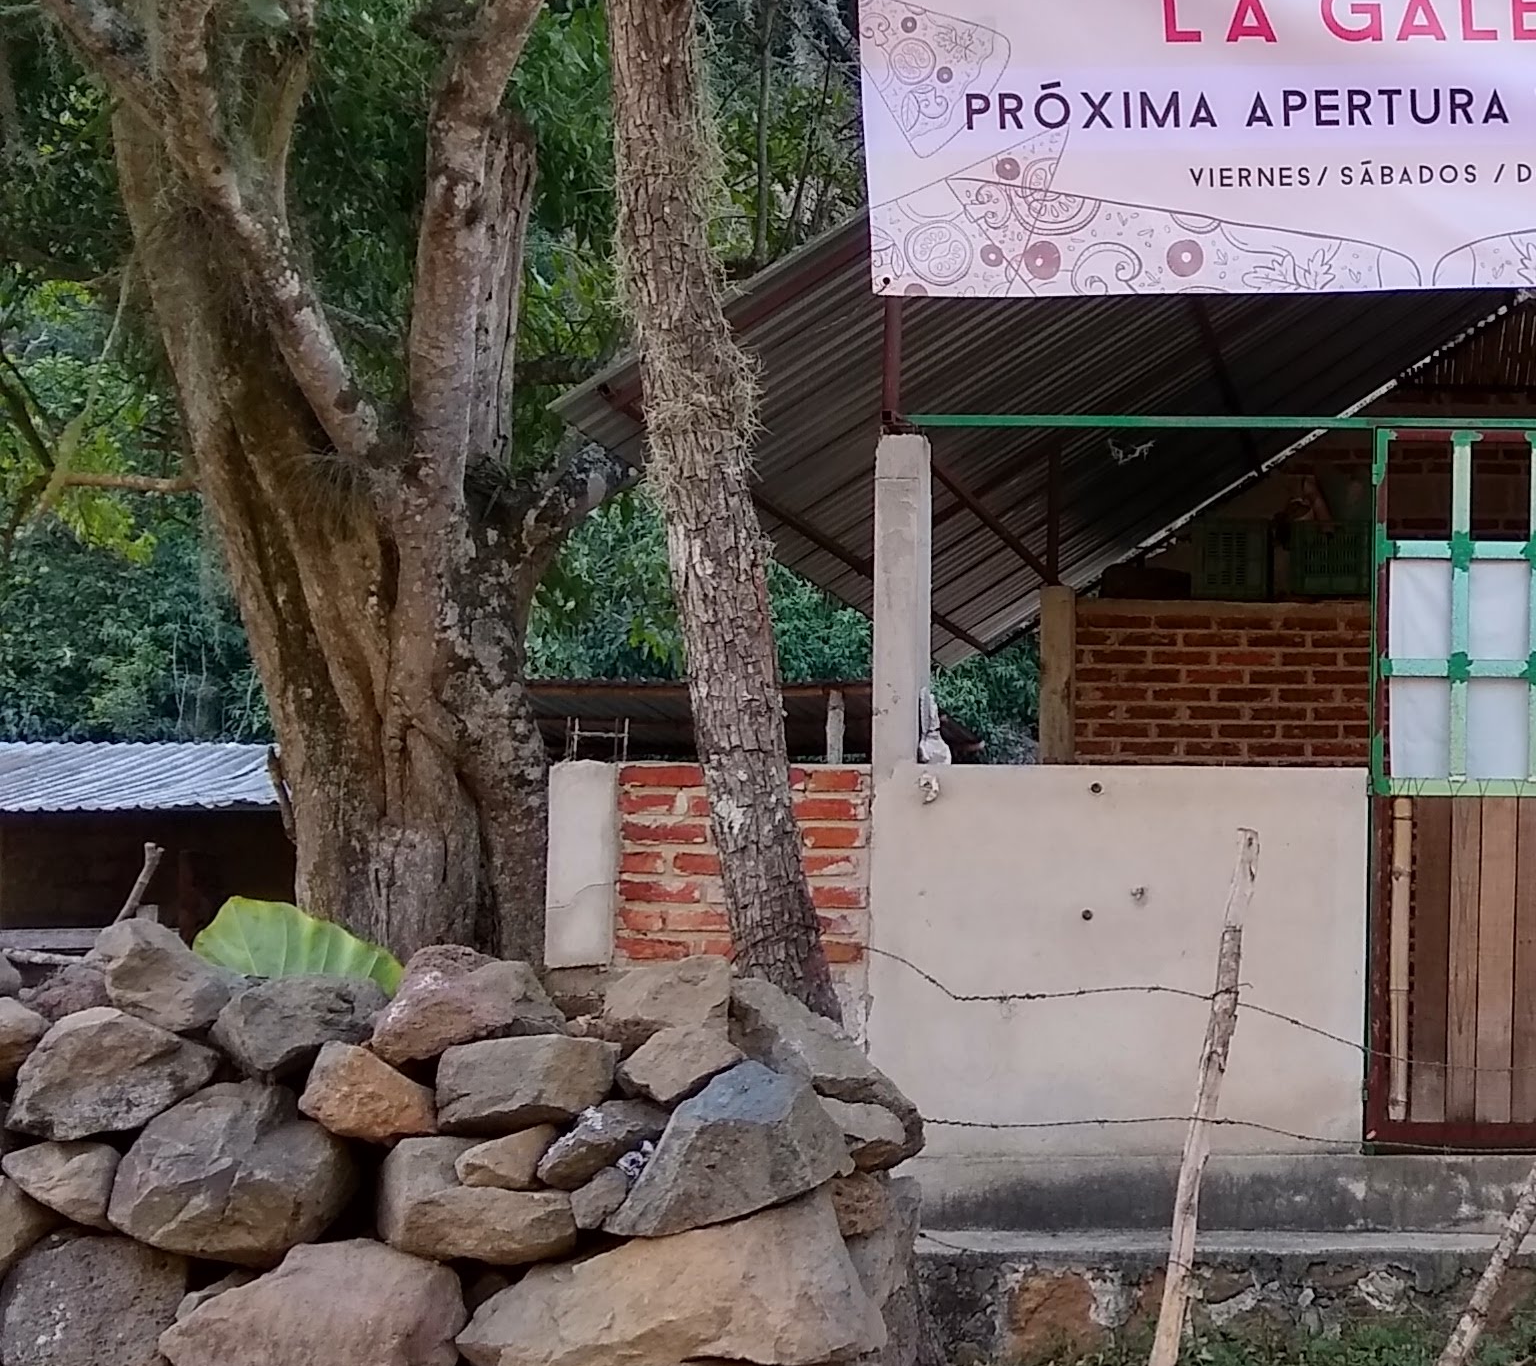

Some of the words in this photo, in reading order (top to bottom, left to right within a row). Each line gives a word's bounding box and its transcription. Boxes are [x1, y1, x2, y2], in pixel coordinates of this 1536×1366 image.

[965, 81, 1218, 131] PRÓXIMA
[1245, 88, 1509, 127] APERTURA
[1340, 160, 1477, 186] SÁBADOS
